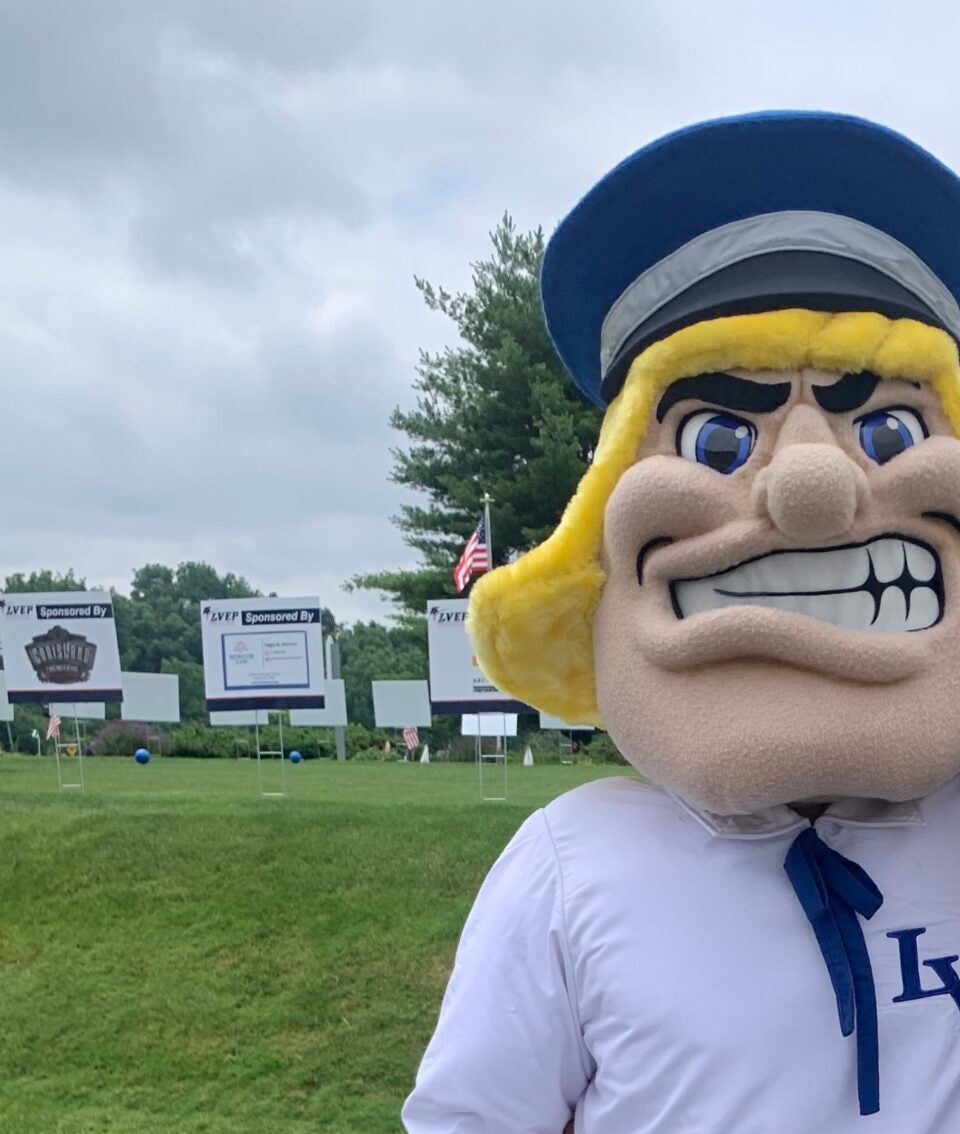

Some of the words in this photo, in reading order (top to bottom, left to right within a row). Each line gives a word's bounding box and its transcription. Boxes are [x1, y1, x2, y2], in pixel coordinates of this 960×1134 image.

[6, 605, 34, 616] LVEP
[40, 606, 91, 618] Sponsored
[93, 605, 107, 618] By
[211, 611, 239, 622] LVEP
[245, 611, 298, 624] Sponsored
[300, 610, 314, 623] By
